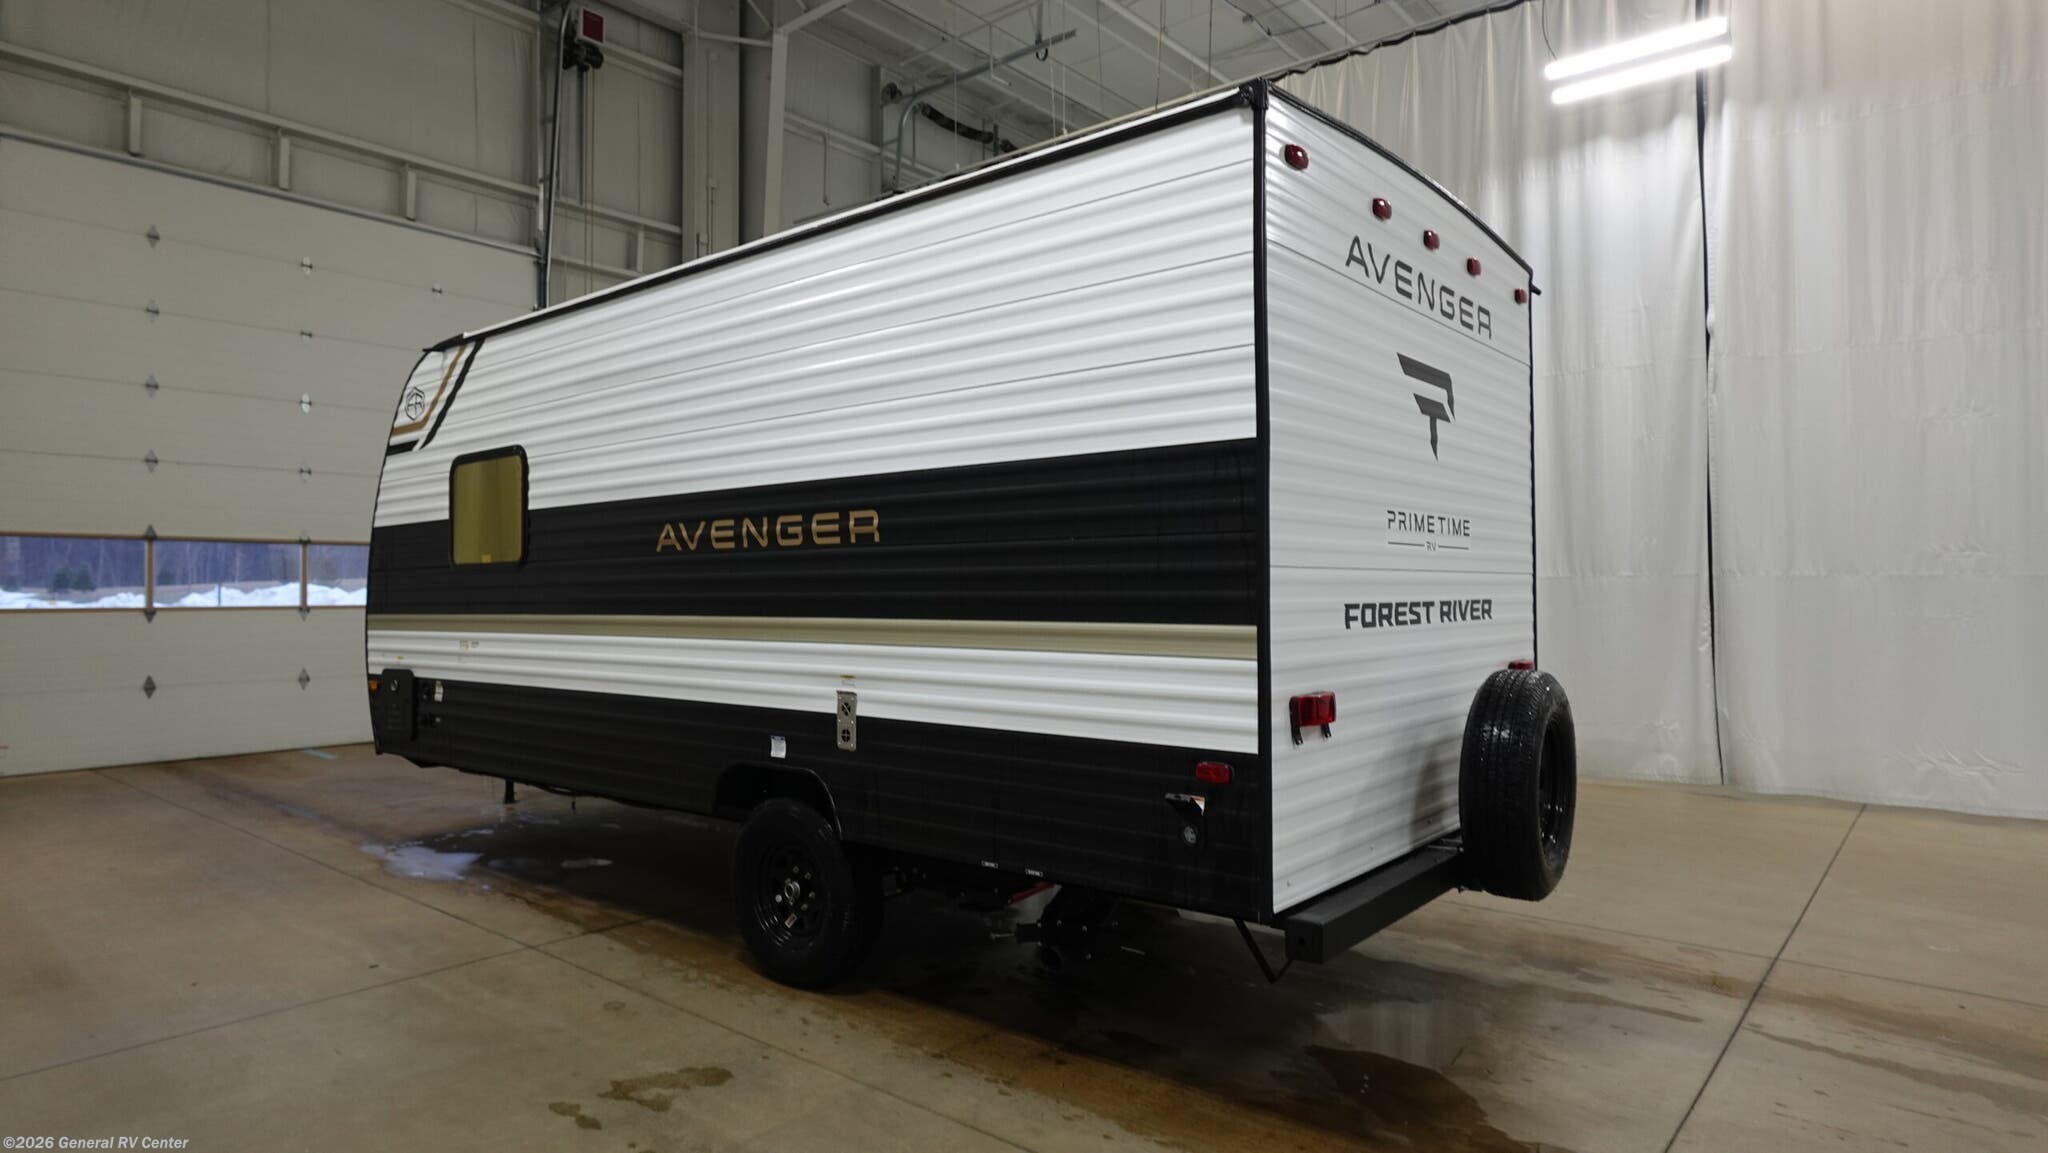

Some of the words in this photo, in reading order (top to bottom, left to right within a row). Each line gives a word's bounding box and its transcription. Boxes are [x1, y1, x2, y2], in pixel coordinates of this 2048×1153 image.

[1345, 235, 1493, 340] AVENGER
[656, 509, 880, 552] AVENGER
[1426, 541, 1437, 551] RV
[1345, 601, 1435, 630] FOREST
[1439, 599, 1492, 623] RIVER
